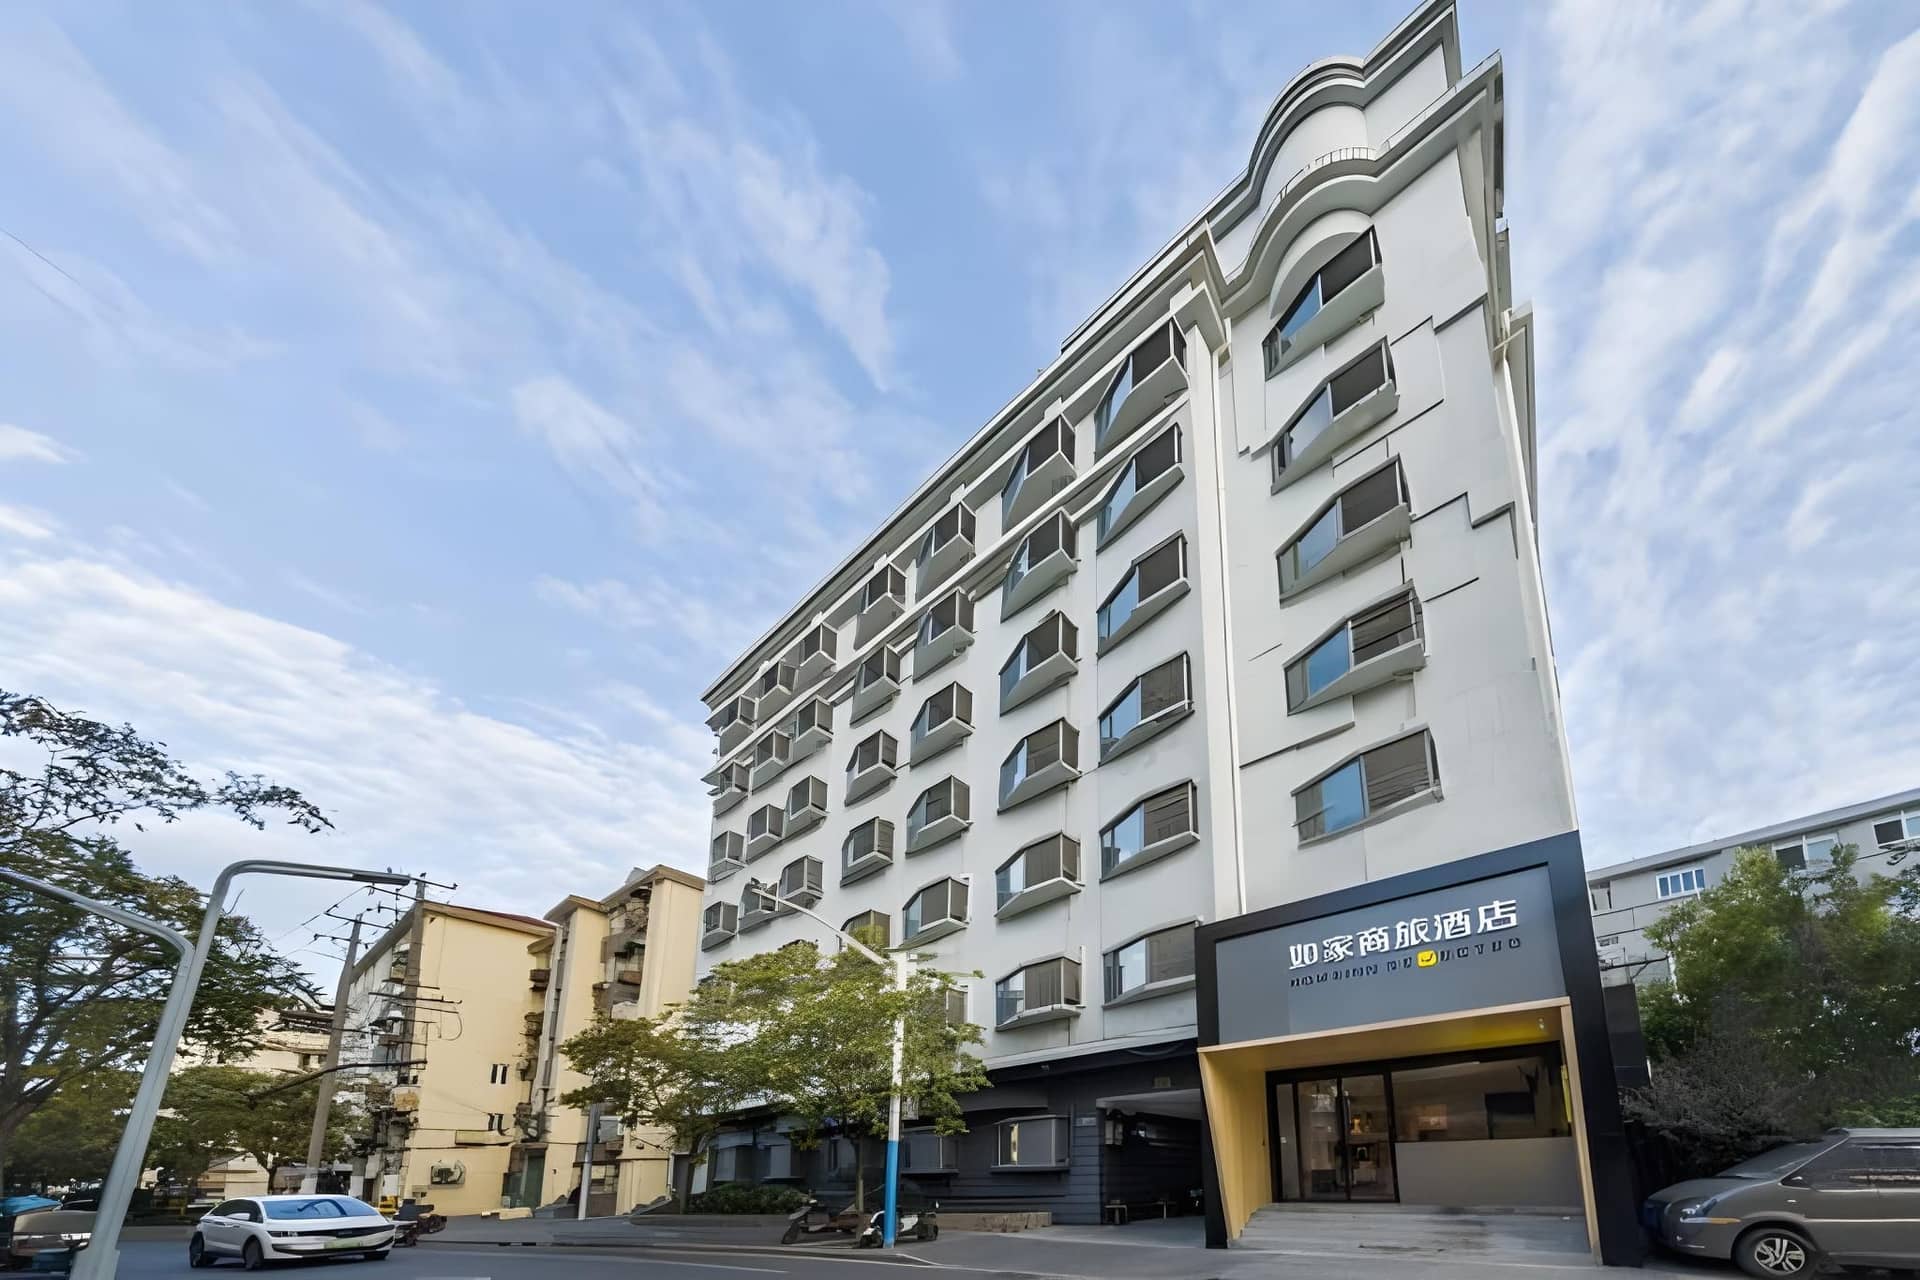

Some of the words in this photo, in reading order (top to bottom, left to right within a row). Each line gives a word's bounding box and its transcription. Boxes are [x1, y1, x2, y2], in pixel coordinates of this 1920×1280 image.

[1288, 899, 1518, 970] 如家商旅酒店
